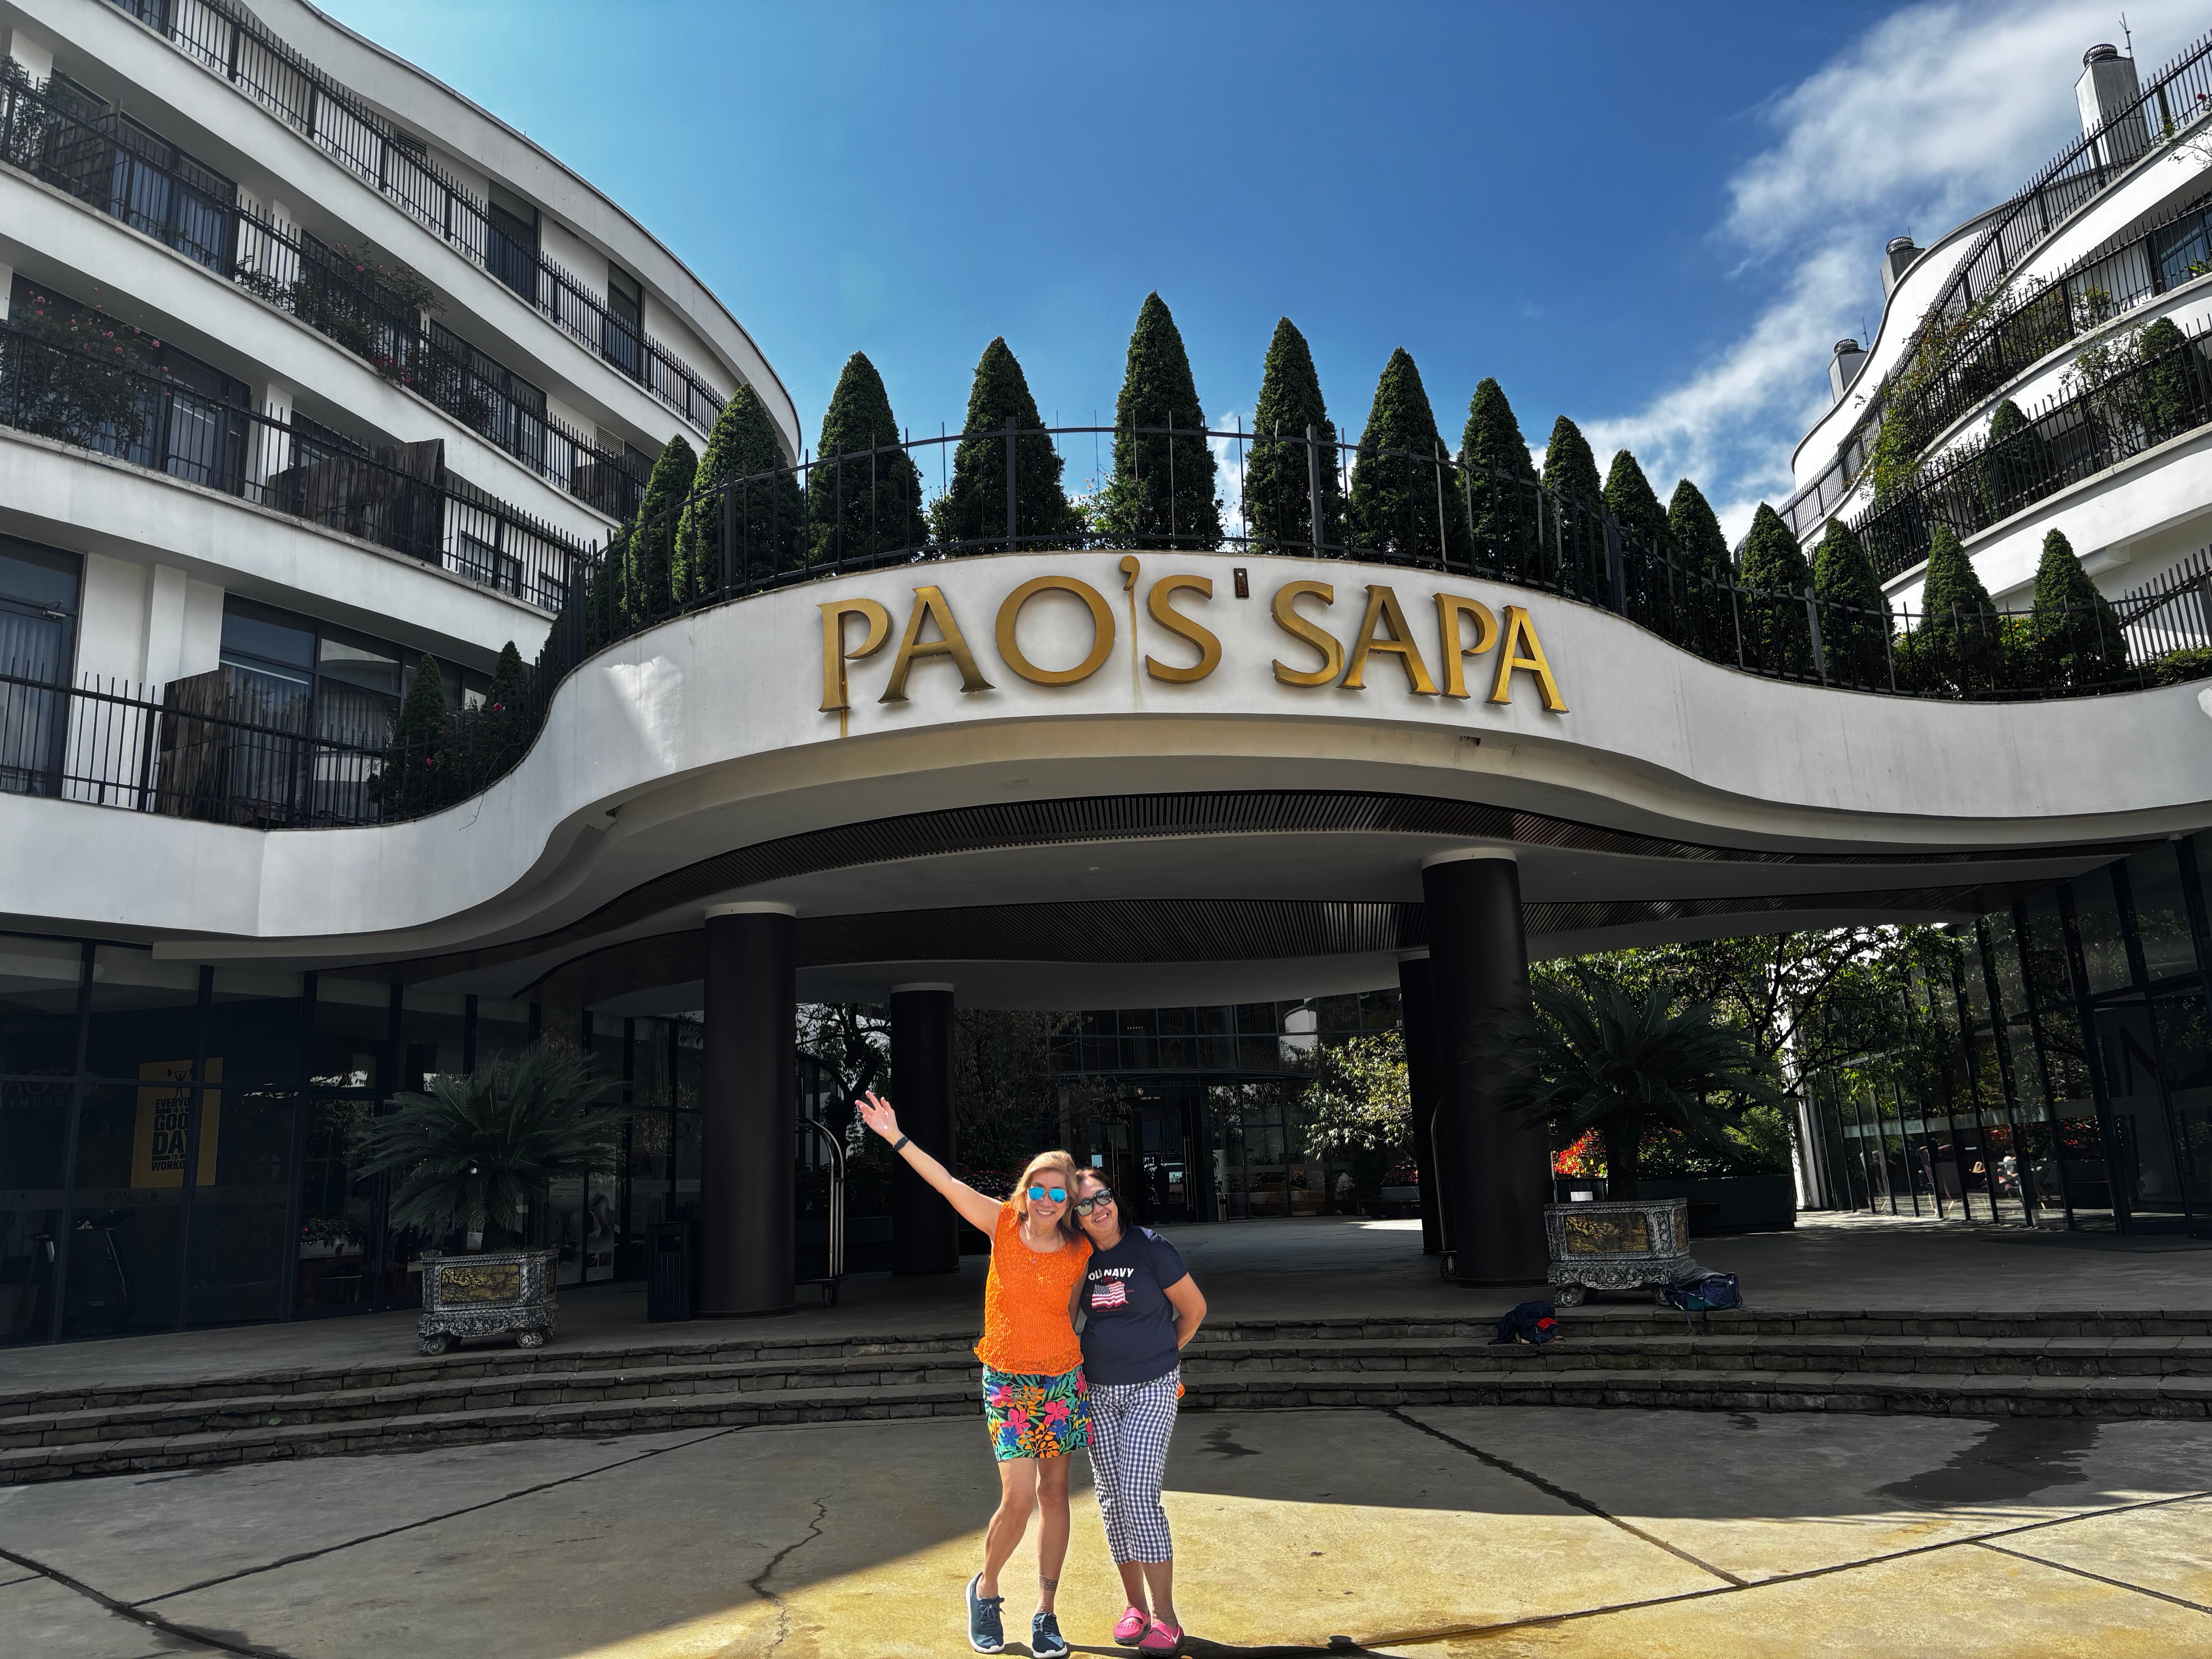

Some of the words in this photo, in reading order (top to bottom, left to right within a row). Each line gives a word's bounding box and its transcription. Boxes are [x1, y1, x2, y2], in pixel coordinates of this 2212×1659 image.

[816, 555, 1222, 713] PAO'S
[1271, 580, 1570, 714] SAPA
[152, 1130, 187, 1156] DA
[1104, 1267, 1134, 1278] NAVY
